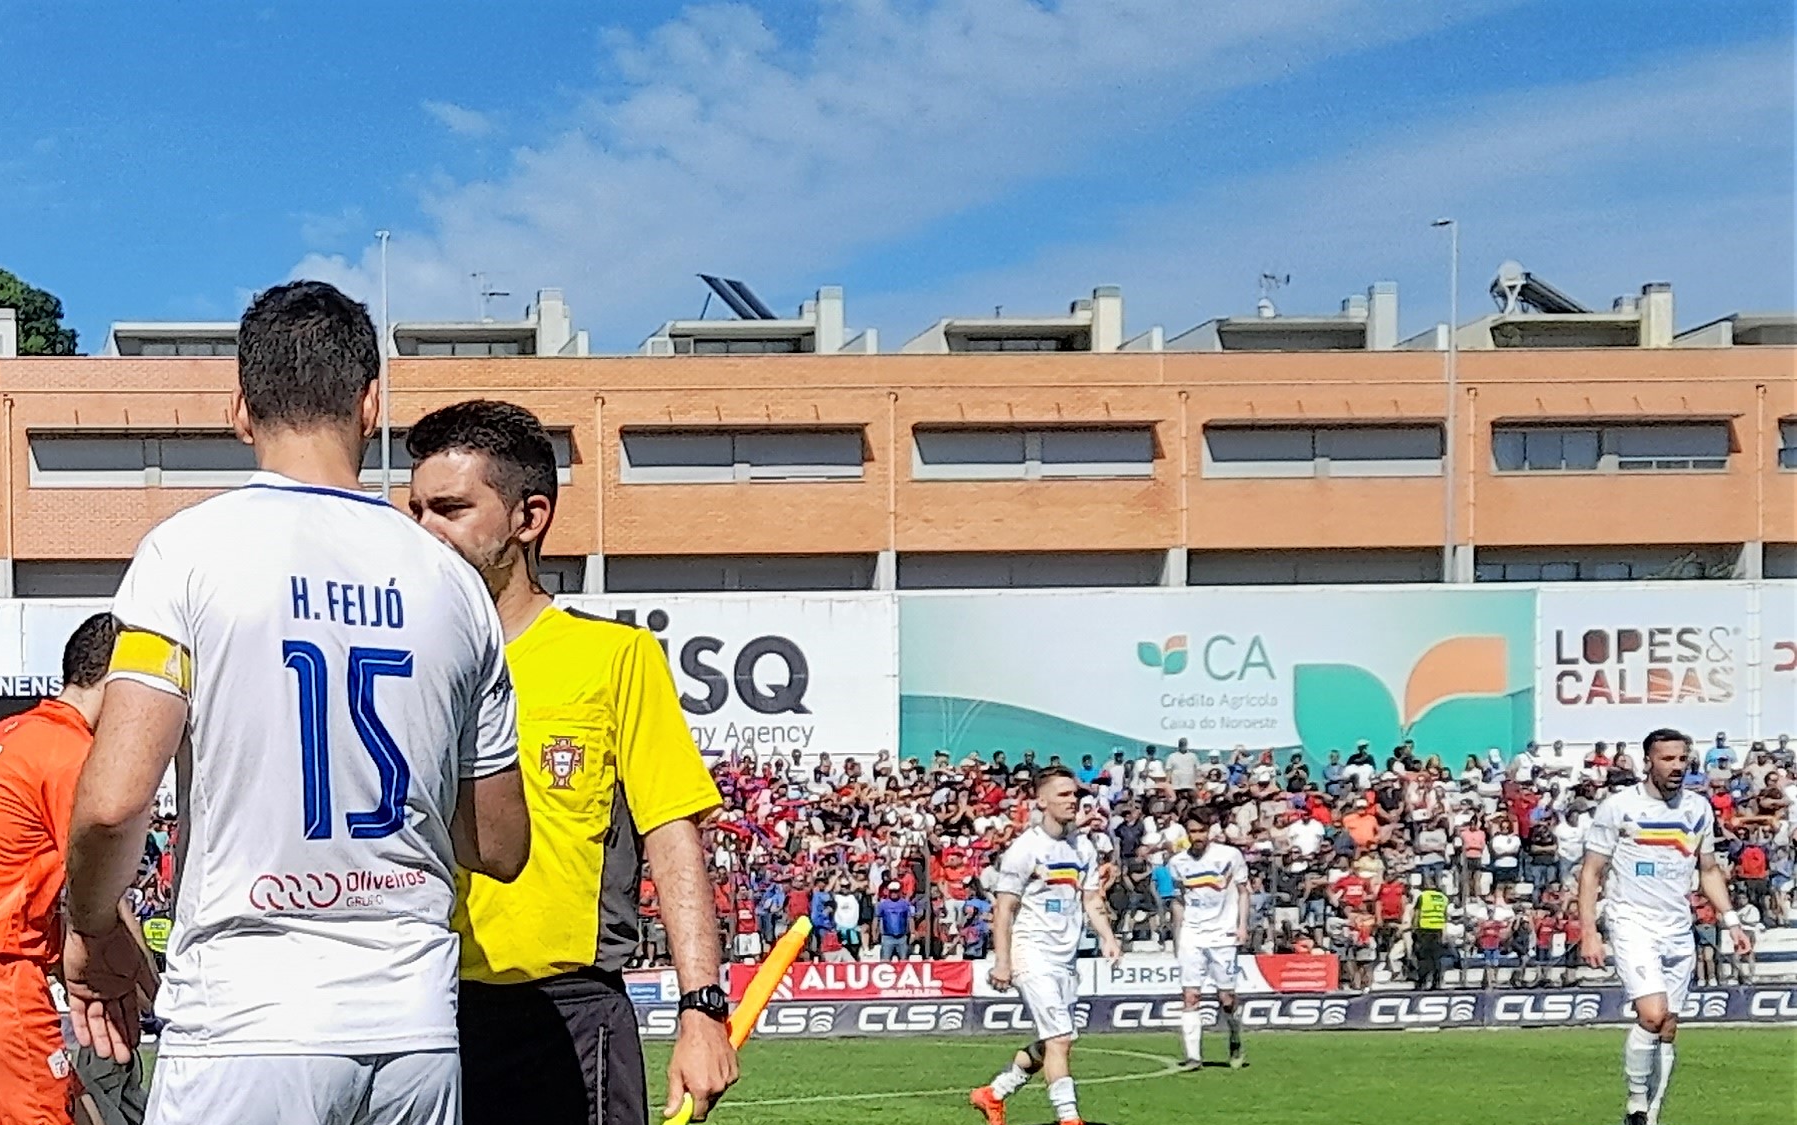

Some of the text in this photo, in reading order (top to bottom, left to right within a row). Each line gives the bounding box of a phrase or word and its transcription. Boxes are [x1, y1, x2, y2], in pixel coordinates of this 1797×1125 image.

[290, 575, 403, 629] H. FEIJÓ
[1204, 634, 1277, 681] CA
[1556, 667, 1734, 705] CALDAS
[1160, 693, 1215, 708] Crédito
[724, 721, 815, 748] Agency
[1160, 716, 1278, 730] Caixa do Noroeste
[281, 639, 414, 840] 15
[346, 868, 427, 892] Oliveiros
[799, 962, 943, 990] ALUGAL
[983, 1003, 1034, 1029] CL
[1750, 991, 1797, 1017] CL
[756, 1007, 807, 1035] LS
